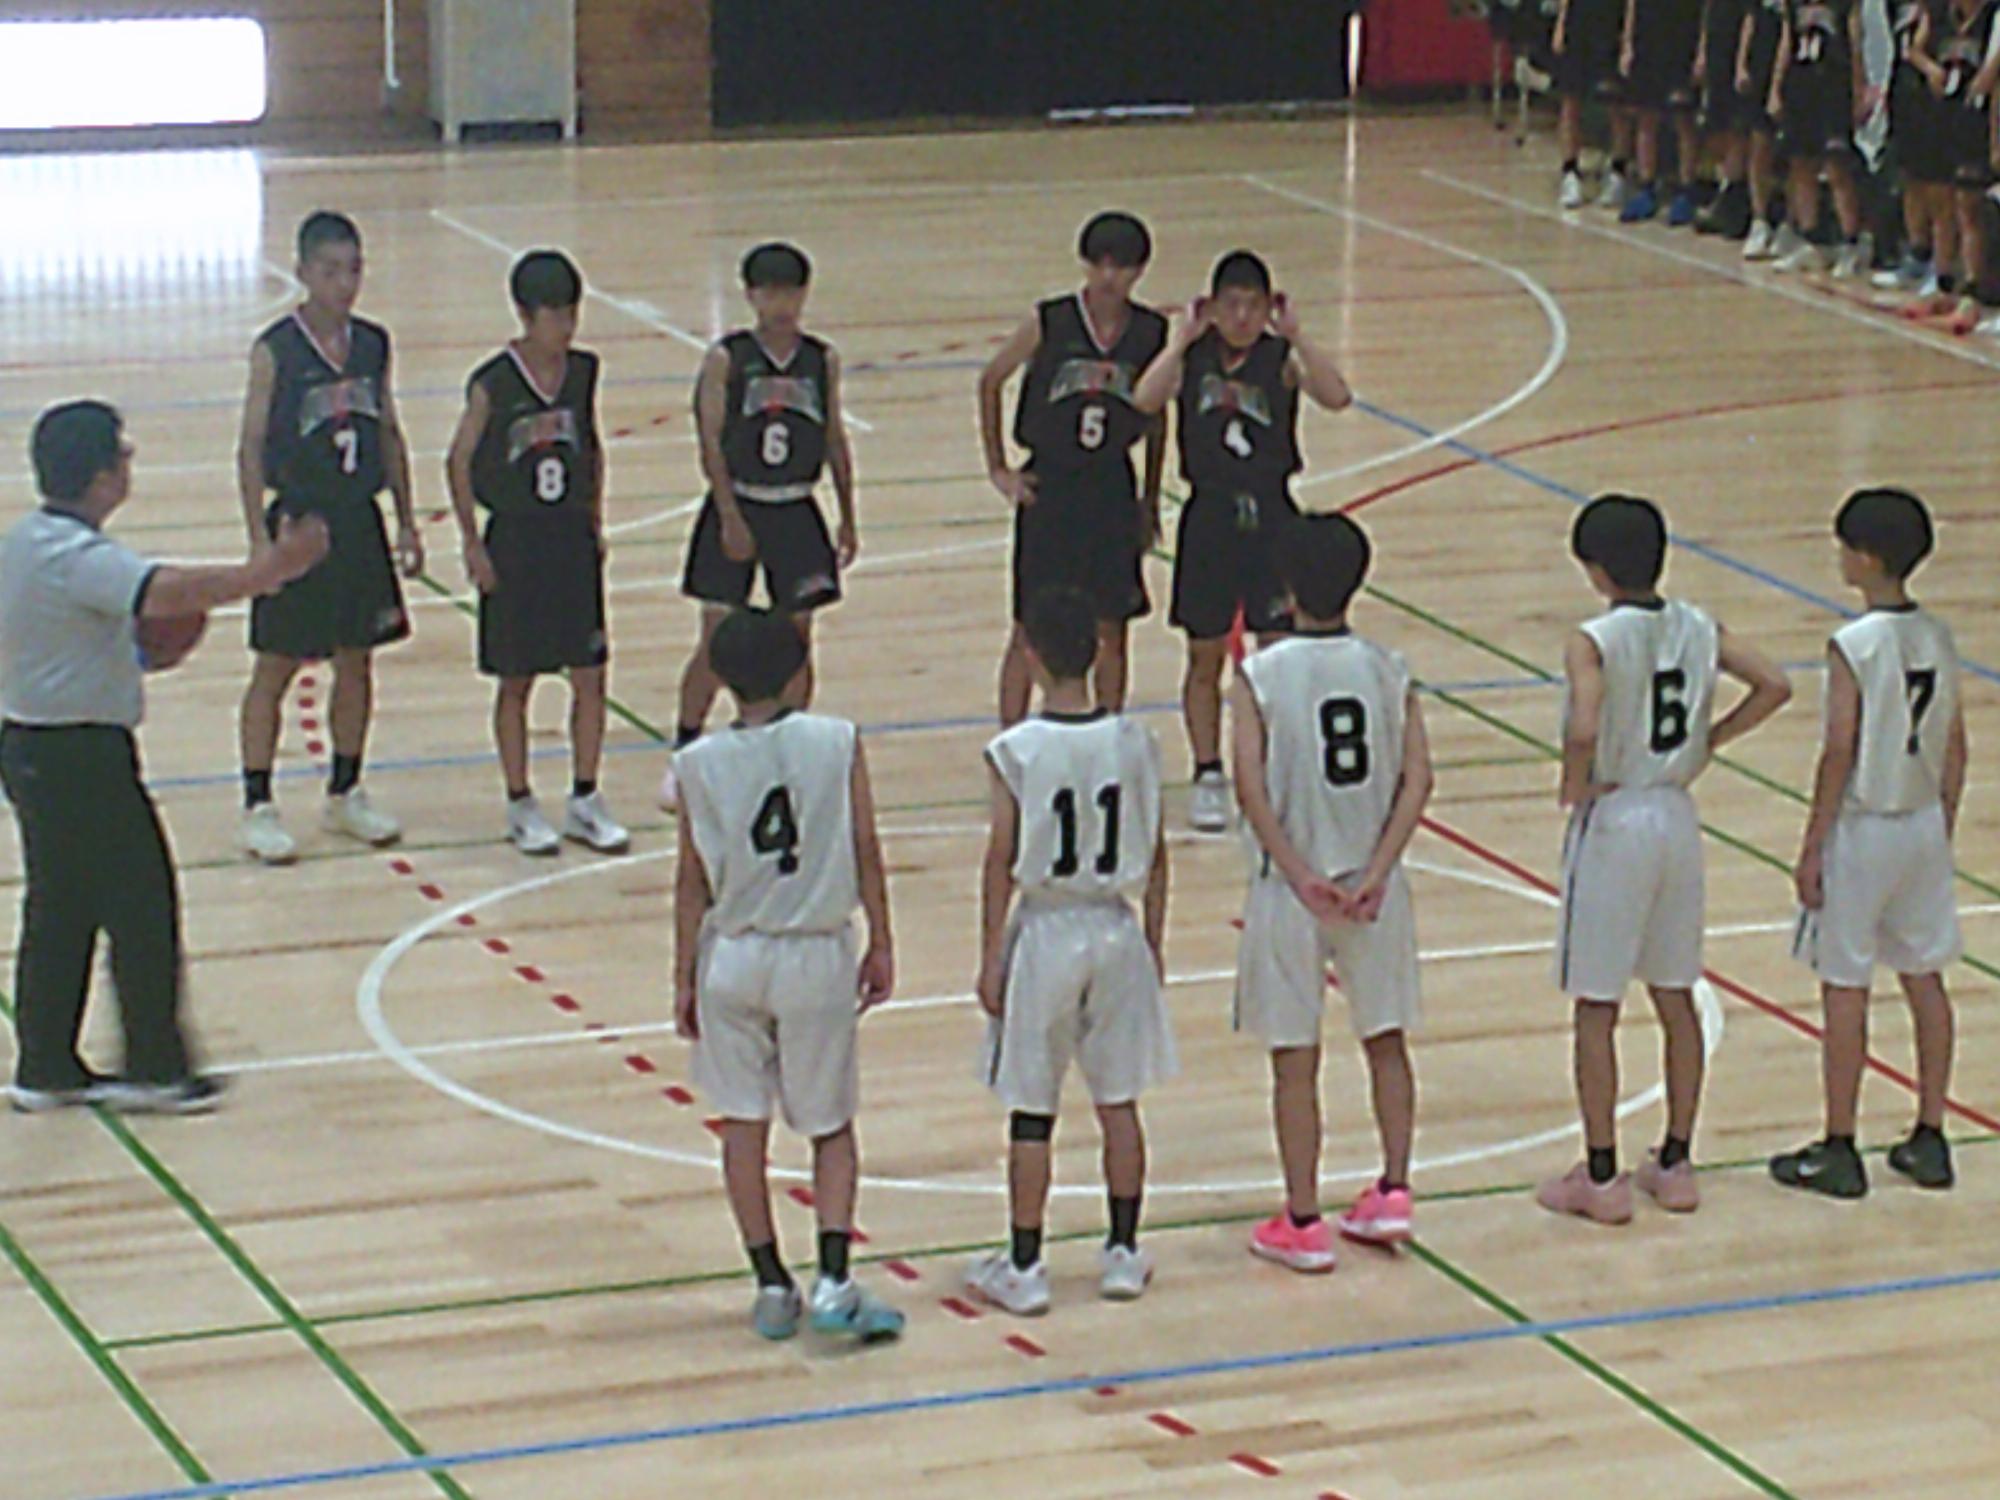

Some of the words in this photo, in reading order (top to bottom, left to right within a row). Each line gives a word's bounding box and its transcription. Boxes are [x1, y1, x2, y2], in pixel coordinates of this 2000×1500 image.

[334, 430, 357, 473] 7
[763, 422, 789, 465] 6
[1080, 406, 1105, 449] 5
[537, 458, 564, 501] 8
[1320, 697, 1367, 786] 8
[1651, 670, 1688, 754] 6
[1906, 669, 1936, 754] 7
[751, 785, 798, 875] 4
[1053, 784, 1121, 877] 11
